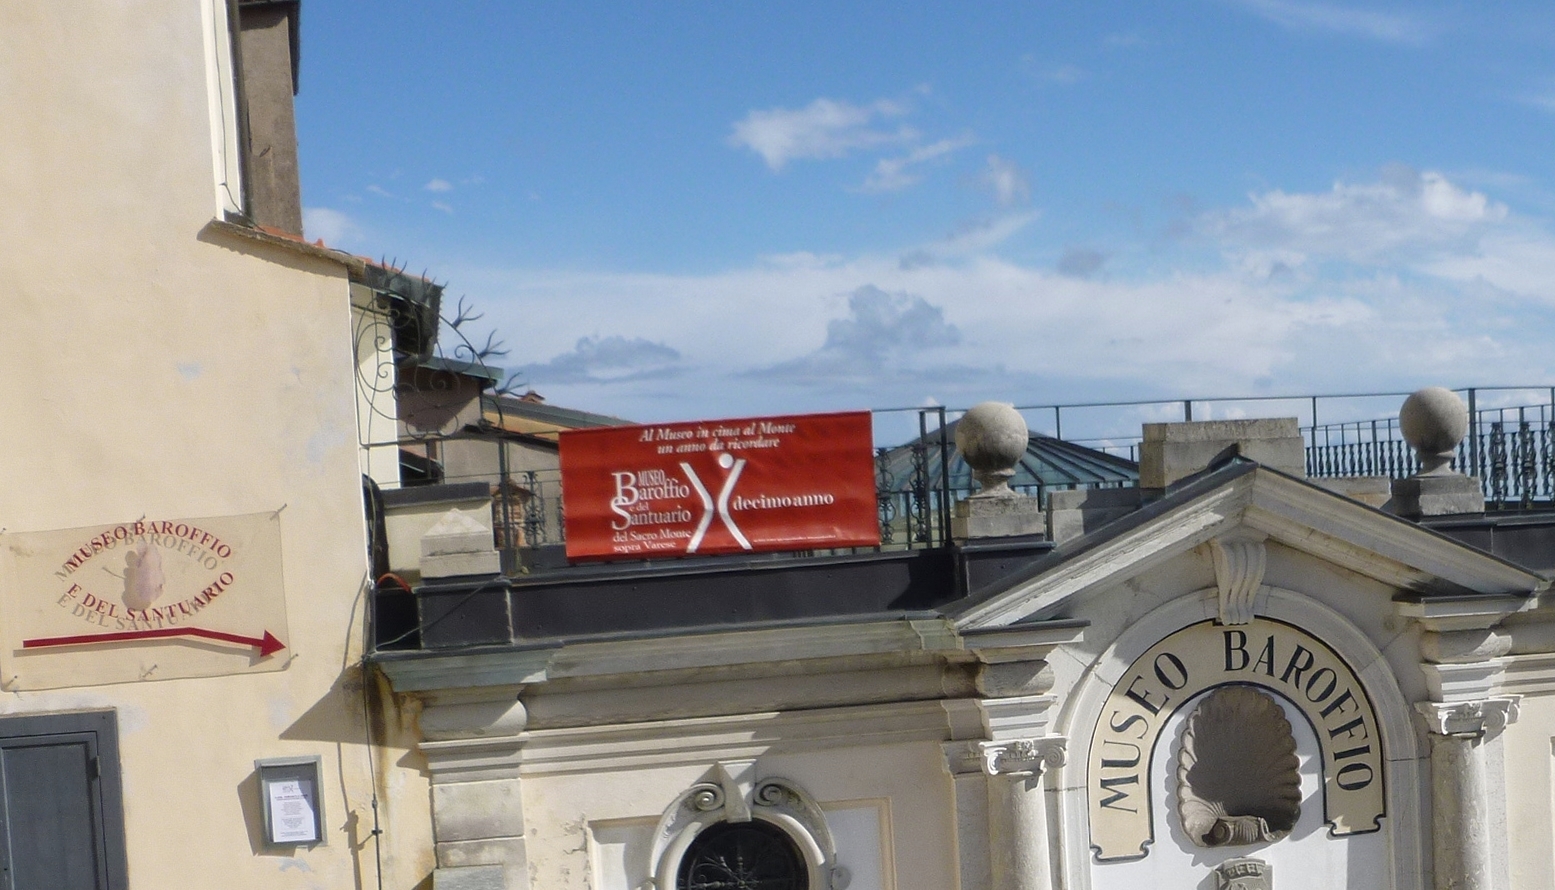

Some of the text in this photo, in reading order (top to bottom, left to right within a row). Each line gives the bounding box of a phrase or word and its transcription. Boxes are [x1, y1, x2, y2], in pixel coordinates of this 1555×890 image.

[639, 422, 795, 442] Al Museo in cima al Monte
[657, 436, 780, 454] un anno da ricordare
[638, 469, 665, 487] MUSEO
[611, 471, 690, 506] Baroffio
[611, 496, 692, 530] Santuario
[637, 502, 649, 511] del
[67, 521, 232, 569] MUSEO BAROFFIO
[613, 529, 692, 542] del Sacro Monte
[614, 541, 676, 553] sopra Varese
[67, 572, 234, 622] E DEL SANTUARIO
[1100, 630, 1373, 814] MUSEO BAROFFIO
